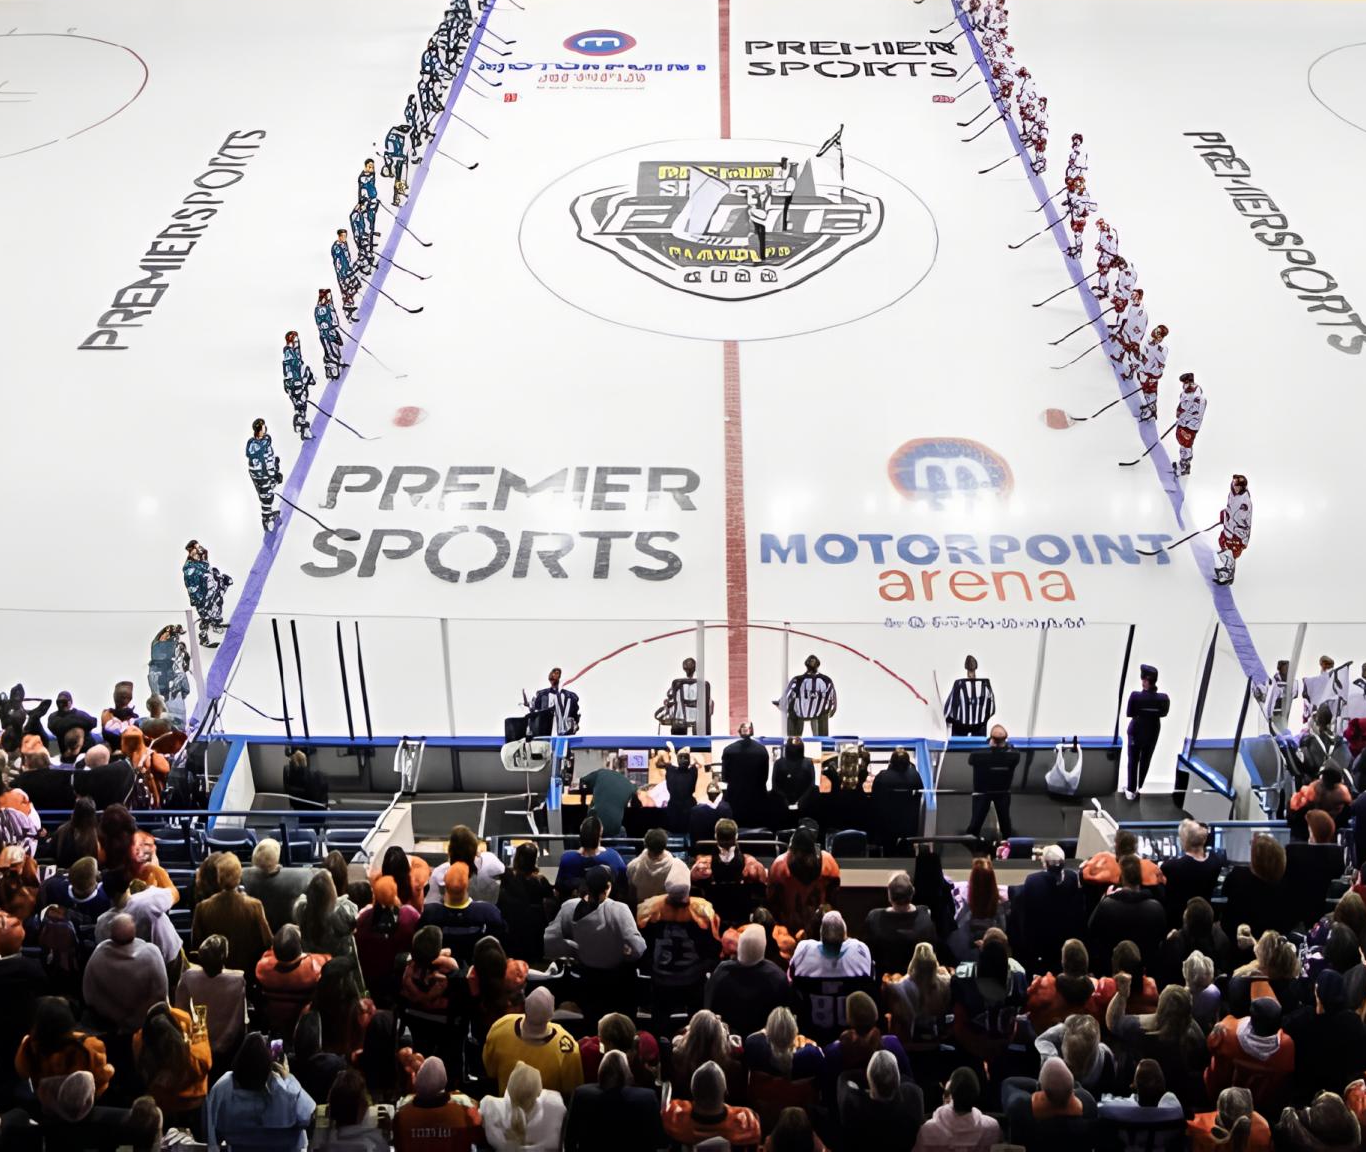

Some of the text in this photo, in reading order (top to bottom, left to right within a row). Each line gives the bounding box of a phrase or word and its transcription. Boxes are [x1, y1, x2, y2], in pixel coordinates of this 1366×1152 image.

[747, 60, 958, 78] SPORTS
[318, 464, 701, 512] PREMIER
[300, 522, 684, 584] SPORTS
[760, 533, 1173, 567] MOTORPOINT
[878, 565, 1077, 603] arena
